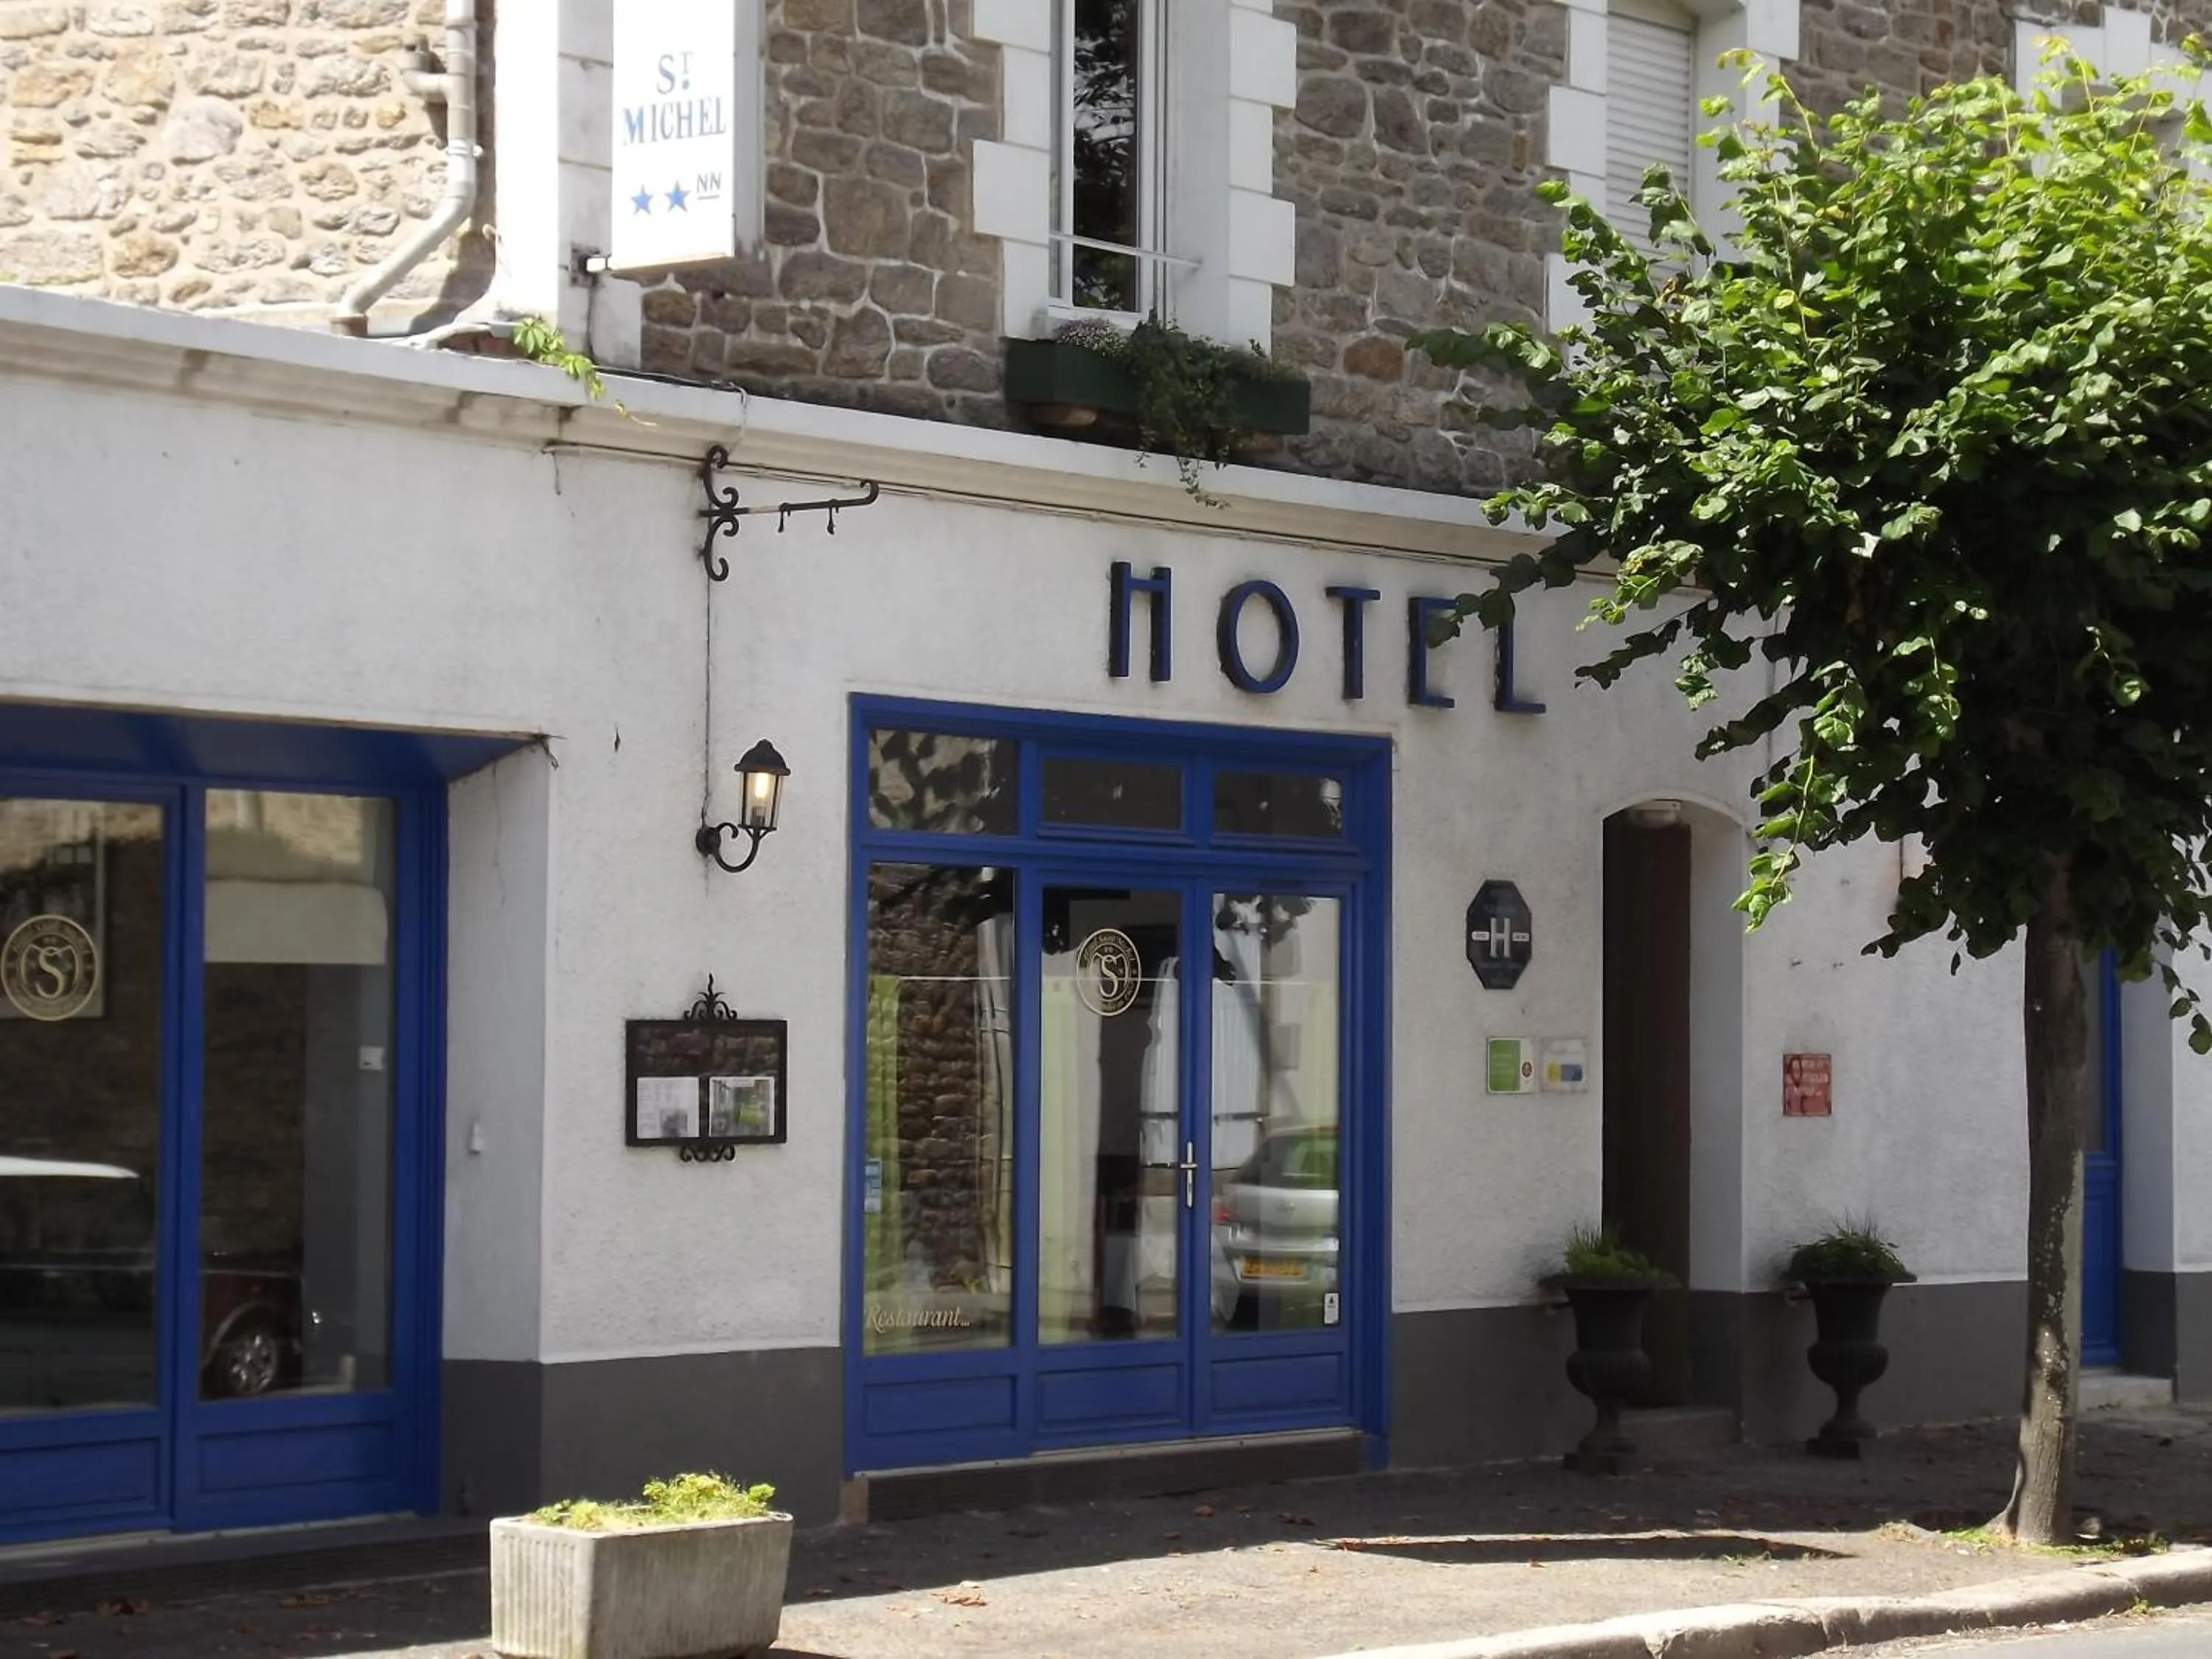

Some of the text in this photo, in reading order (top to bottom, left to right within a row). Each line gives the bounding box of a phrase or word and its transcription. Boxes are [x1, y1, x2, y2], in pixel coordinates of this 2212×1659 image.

[624, 97, 726, 145] MICHEL
[696, 173, 722, 193] NN
[1108, 561, 1546, 713] HOTEL
[1489, 918, 1510, 957] H
